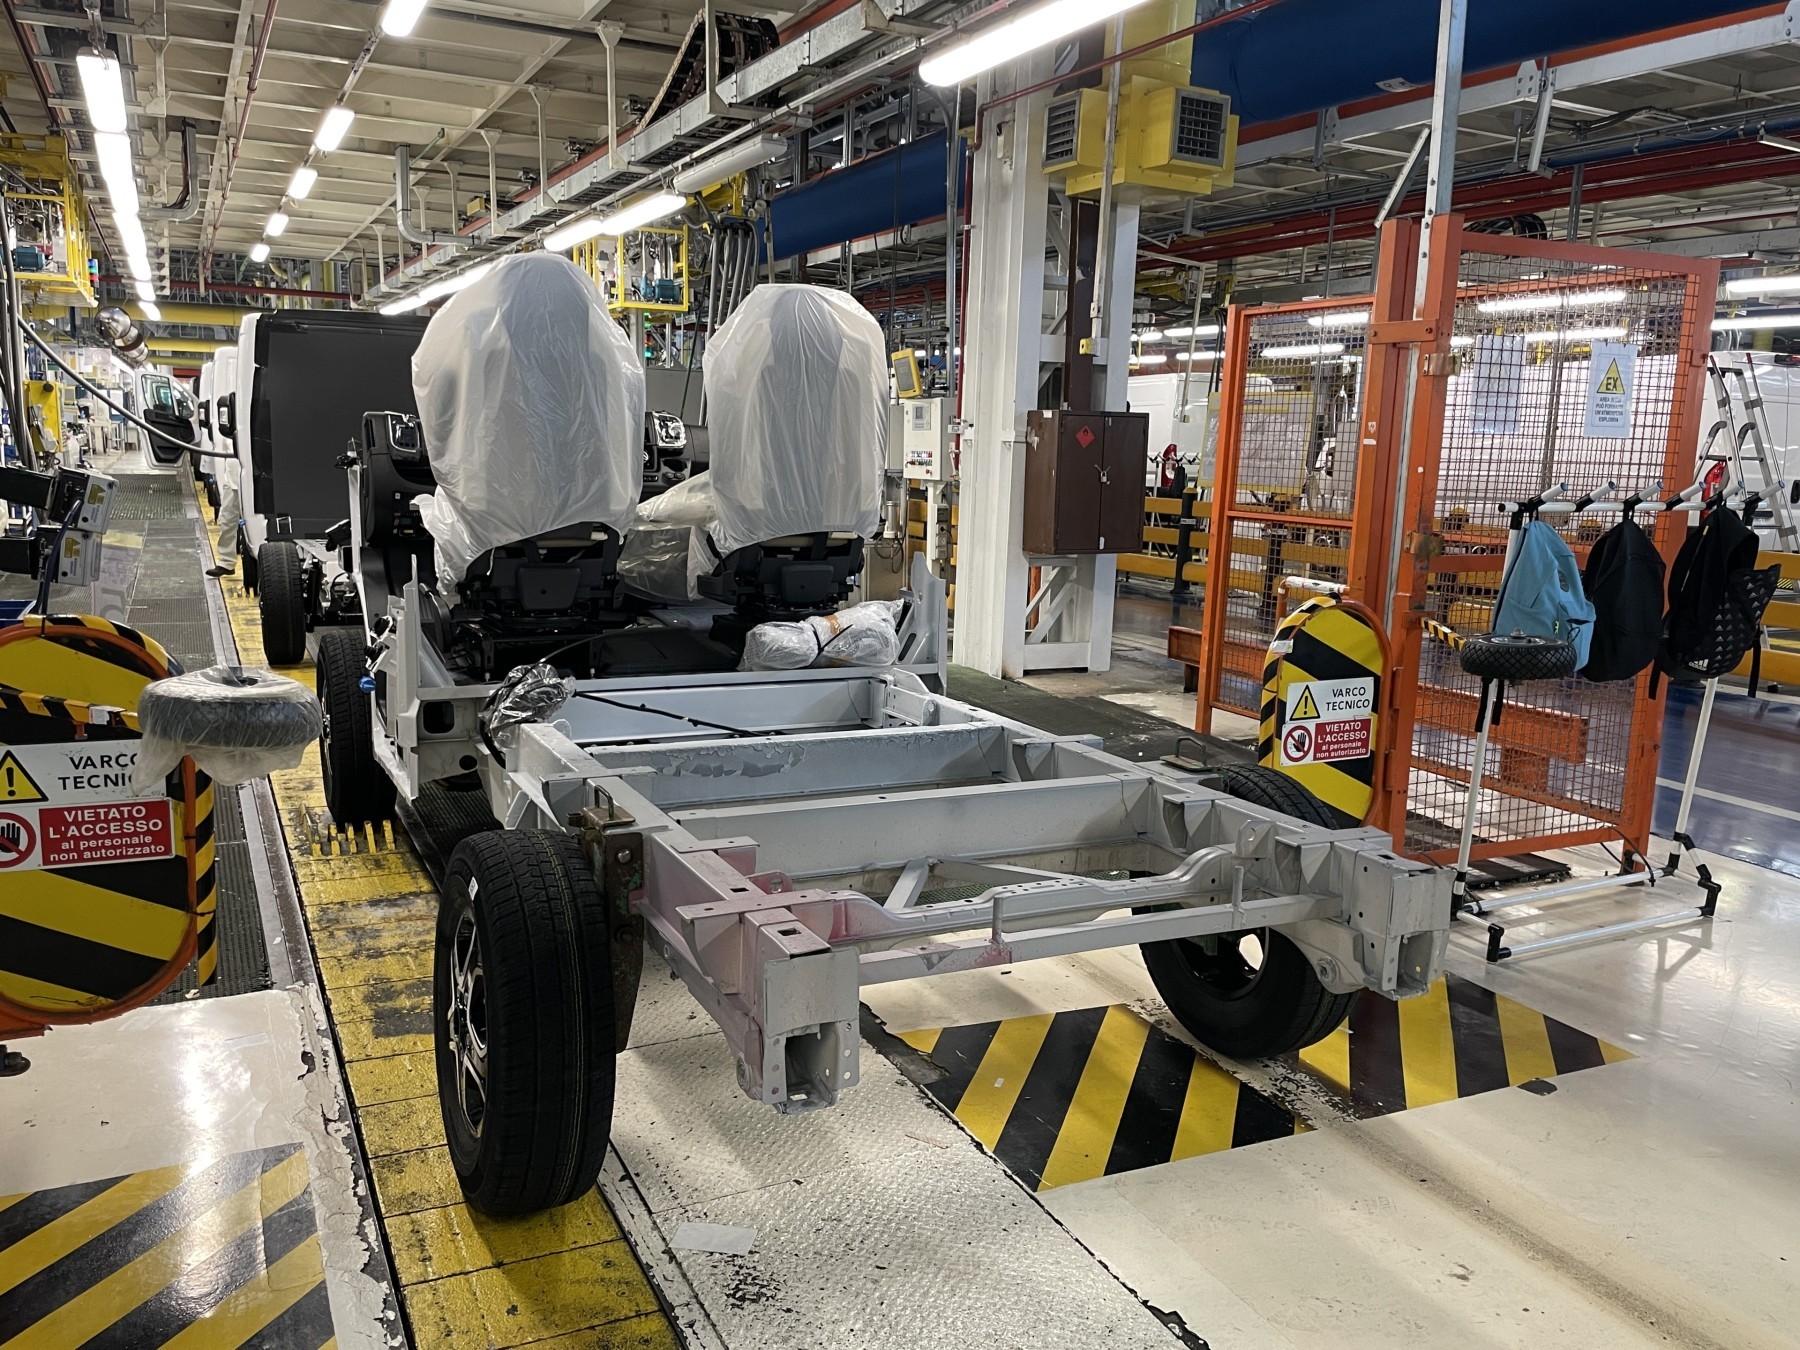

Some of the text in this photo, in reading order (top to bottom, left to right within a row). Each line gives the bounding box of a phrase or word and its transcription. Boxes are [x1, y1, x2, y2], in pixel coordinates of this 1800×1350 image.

[1605, 377, 1618, 391] EX
[1332, 687, 1366, 697] VARCO
[1326, 699, 1370, 711] TECNICO
[1326, 722, 1361, 732] VIETATO
[1318, 731, 1367, 742] L'ACCESSO
[1330, 741, 1361, 750] personale
[1331, 748, 1366, 756] autorizzato
[58, 772, 132, 790] TECNI
[63, 805, 146, 822] VIETATO
[49, 819, 163, 838] L'ACCESSO
[61, 834, 153, 850] al personale
[50, 844, 165, 861] non autorizzato
